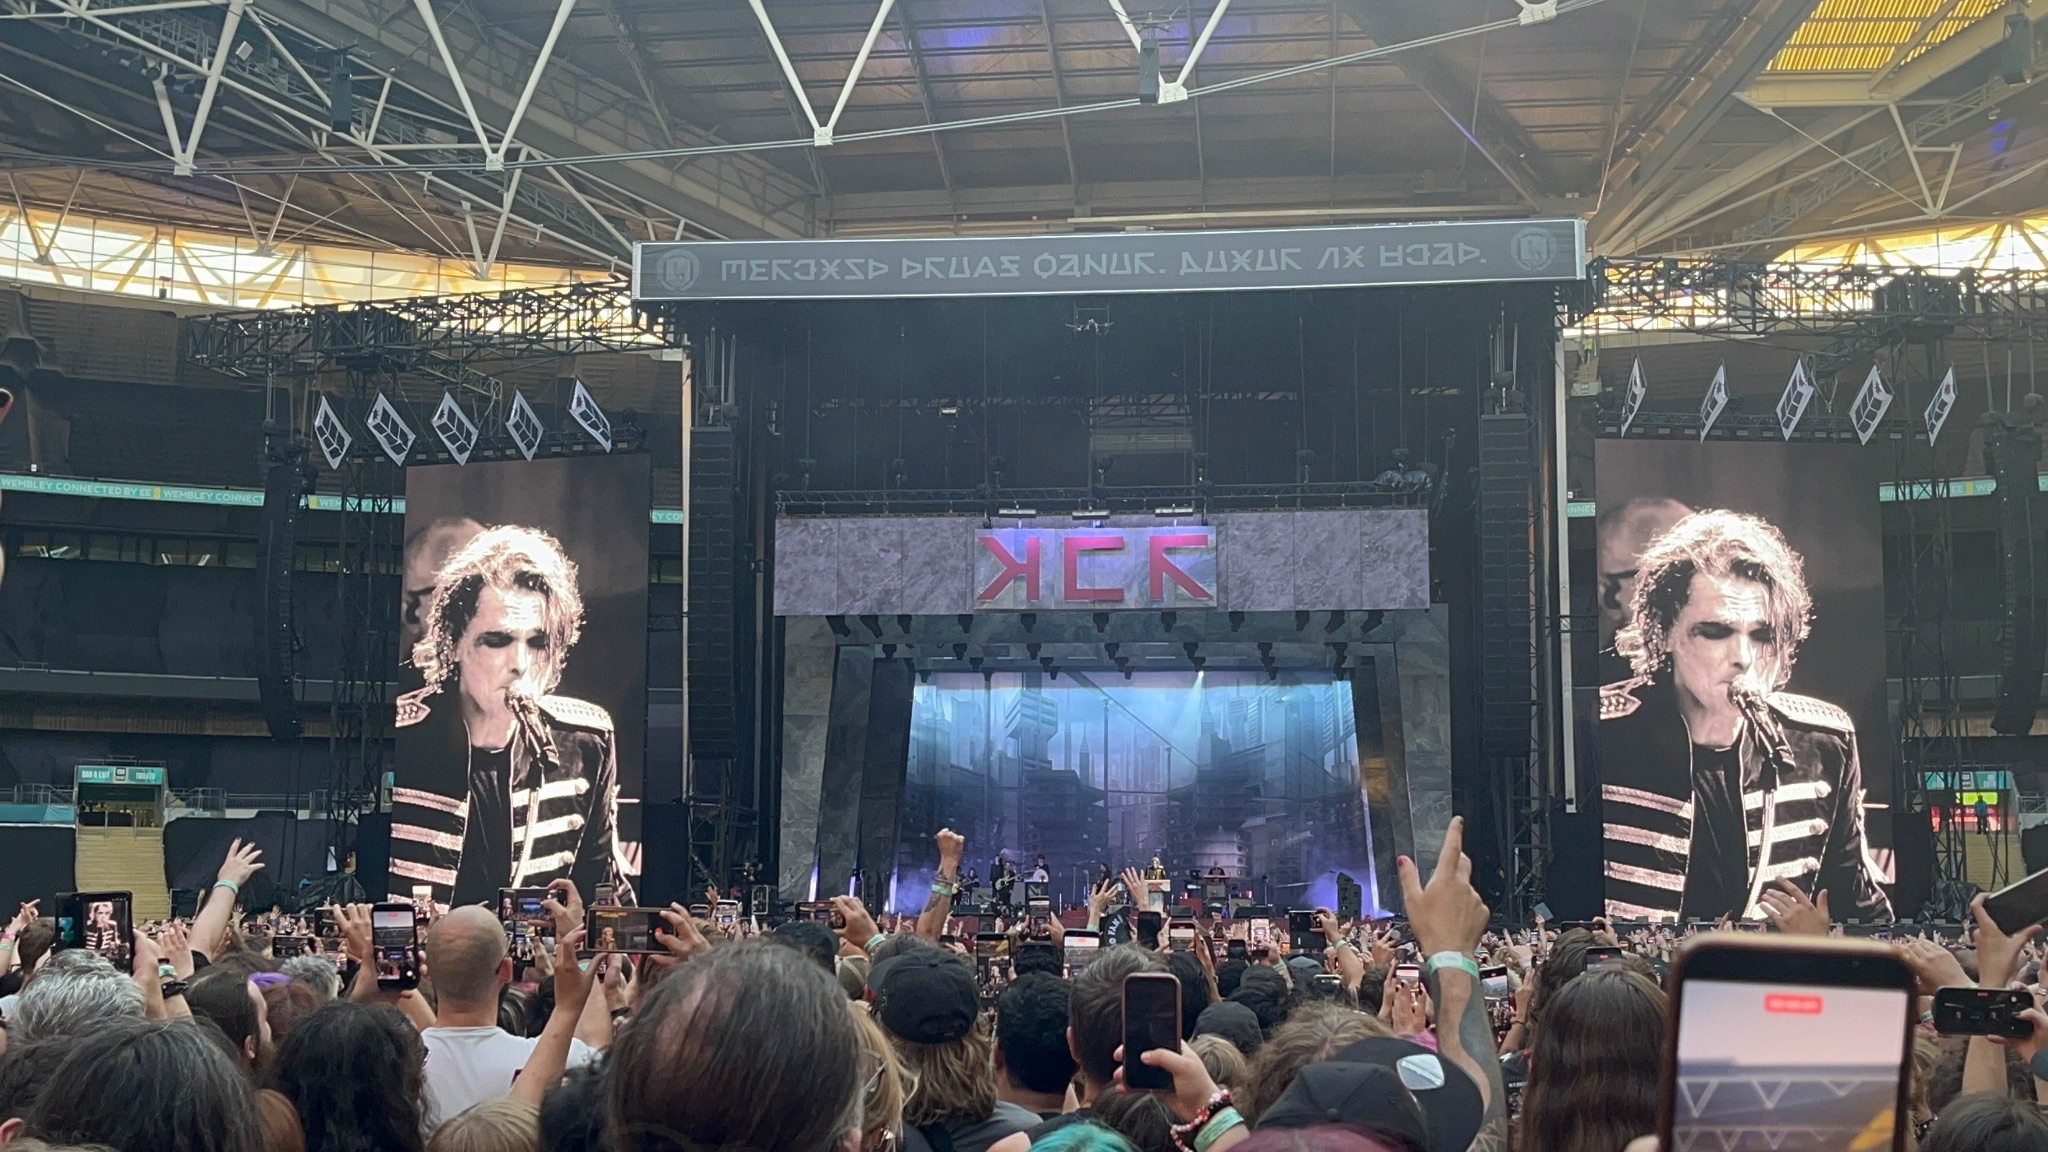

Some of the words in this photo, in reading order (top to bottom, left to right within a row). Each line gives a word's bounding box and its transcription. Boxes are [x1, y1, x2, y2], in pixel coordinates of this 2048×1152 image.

[1, 479, 52, 490] WEMBLEY
[55, 483, 121, 495] CONNECTED
[124, 487, 137, 496] BY
[140, 488, 151, 497] EE
[163, 490, 213, 501] WEMBLEY
